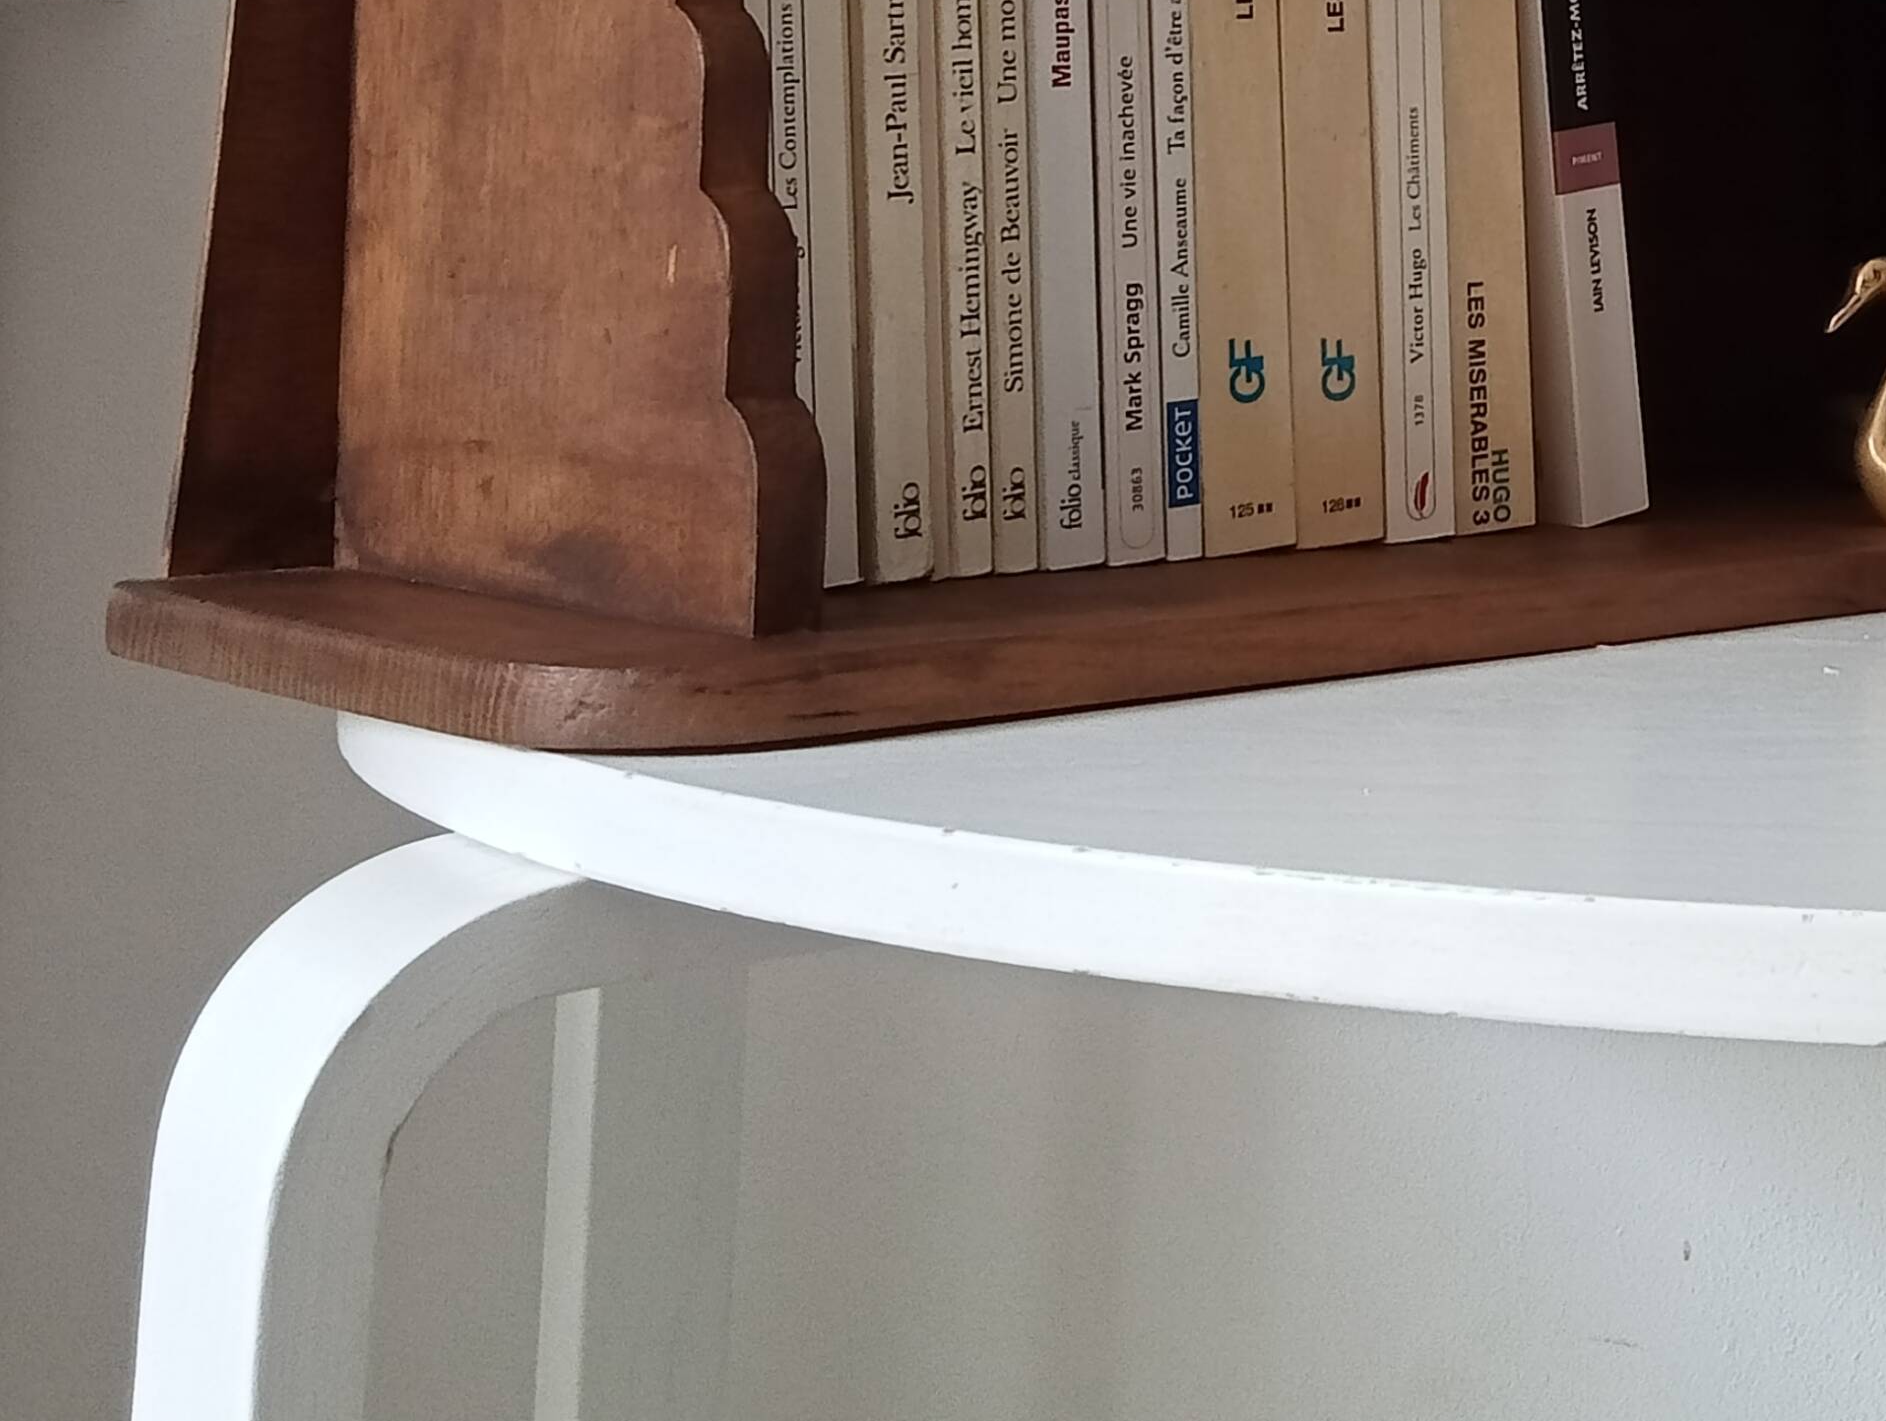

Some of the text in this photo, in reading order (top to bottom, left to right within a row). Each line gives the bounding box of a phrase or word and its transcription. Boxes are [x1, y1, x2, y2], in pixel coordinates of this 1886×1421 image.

[1164, 10, 1183, 65] d'être
[776, 3, 800, 210] Les Contemplations
[952, 59, 975, 113] vieil
[997, 50, 1017, 104] Une
[1167, 72, 1187, 124] façon
[884, 73, 914, 204] Jean-Paul
[955, 120, 976, 154] Le
[1167, 130, 1185, 155] Ta
[998, 128, 1021, 243] Beauvoir
[957, 182, 984, 338] Hemingway
[1118, 56, 1145, 431] Mark Spragg Une vie inachevée
[1170, 178, 1189, 278] Anseaume
[1406, 107, 1426, 363] Victor Hugo Les Châtiments
[1586, 208, 1604, 312] IAIN LEVISON
[1001, 252, 1022, 284] de
[1003, 293, 1024, 393] Simone
[1170, 284, 1190, 358] Camille
[962, 348, 984, 433] Ernest
[1229, 338, 1265, 404] GF
[1321, 338, 1356, 402] GF
[1467, 281, 1490, 526] LES MISERABLES 3
[961, 465, 987, 521] folio
[1002, 467, 1025, 521] folio
[1059, 420, 1083, 529] folio classique
[1131, 467, 1144, 512] 30863
[1491, 449, 1511, 522] HUGO
[894, 482, 923, 539] folio
[1229, 503, 1254, 519] 125
